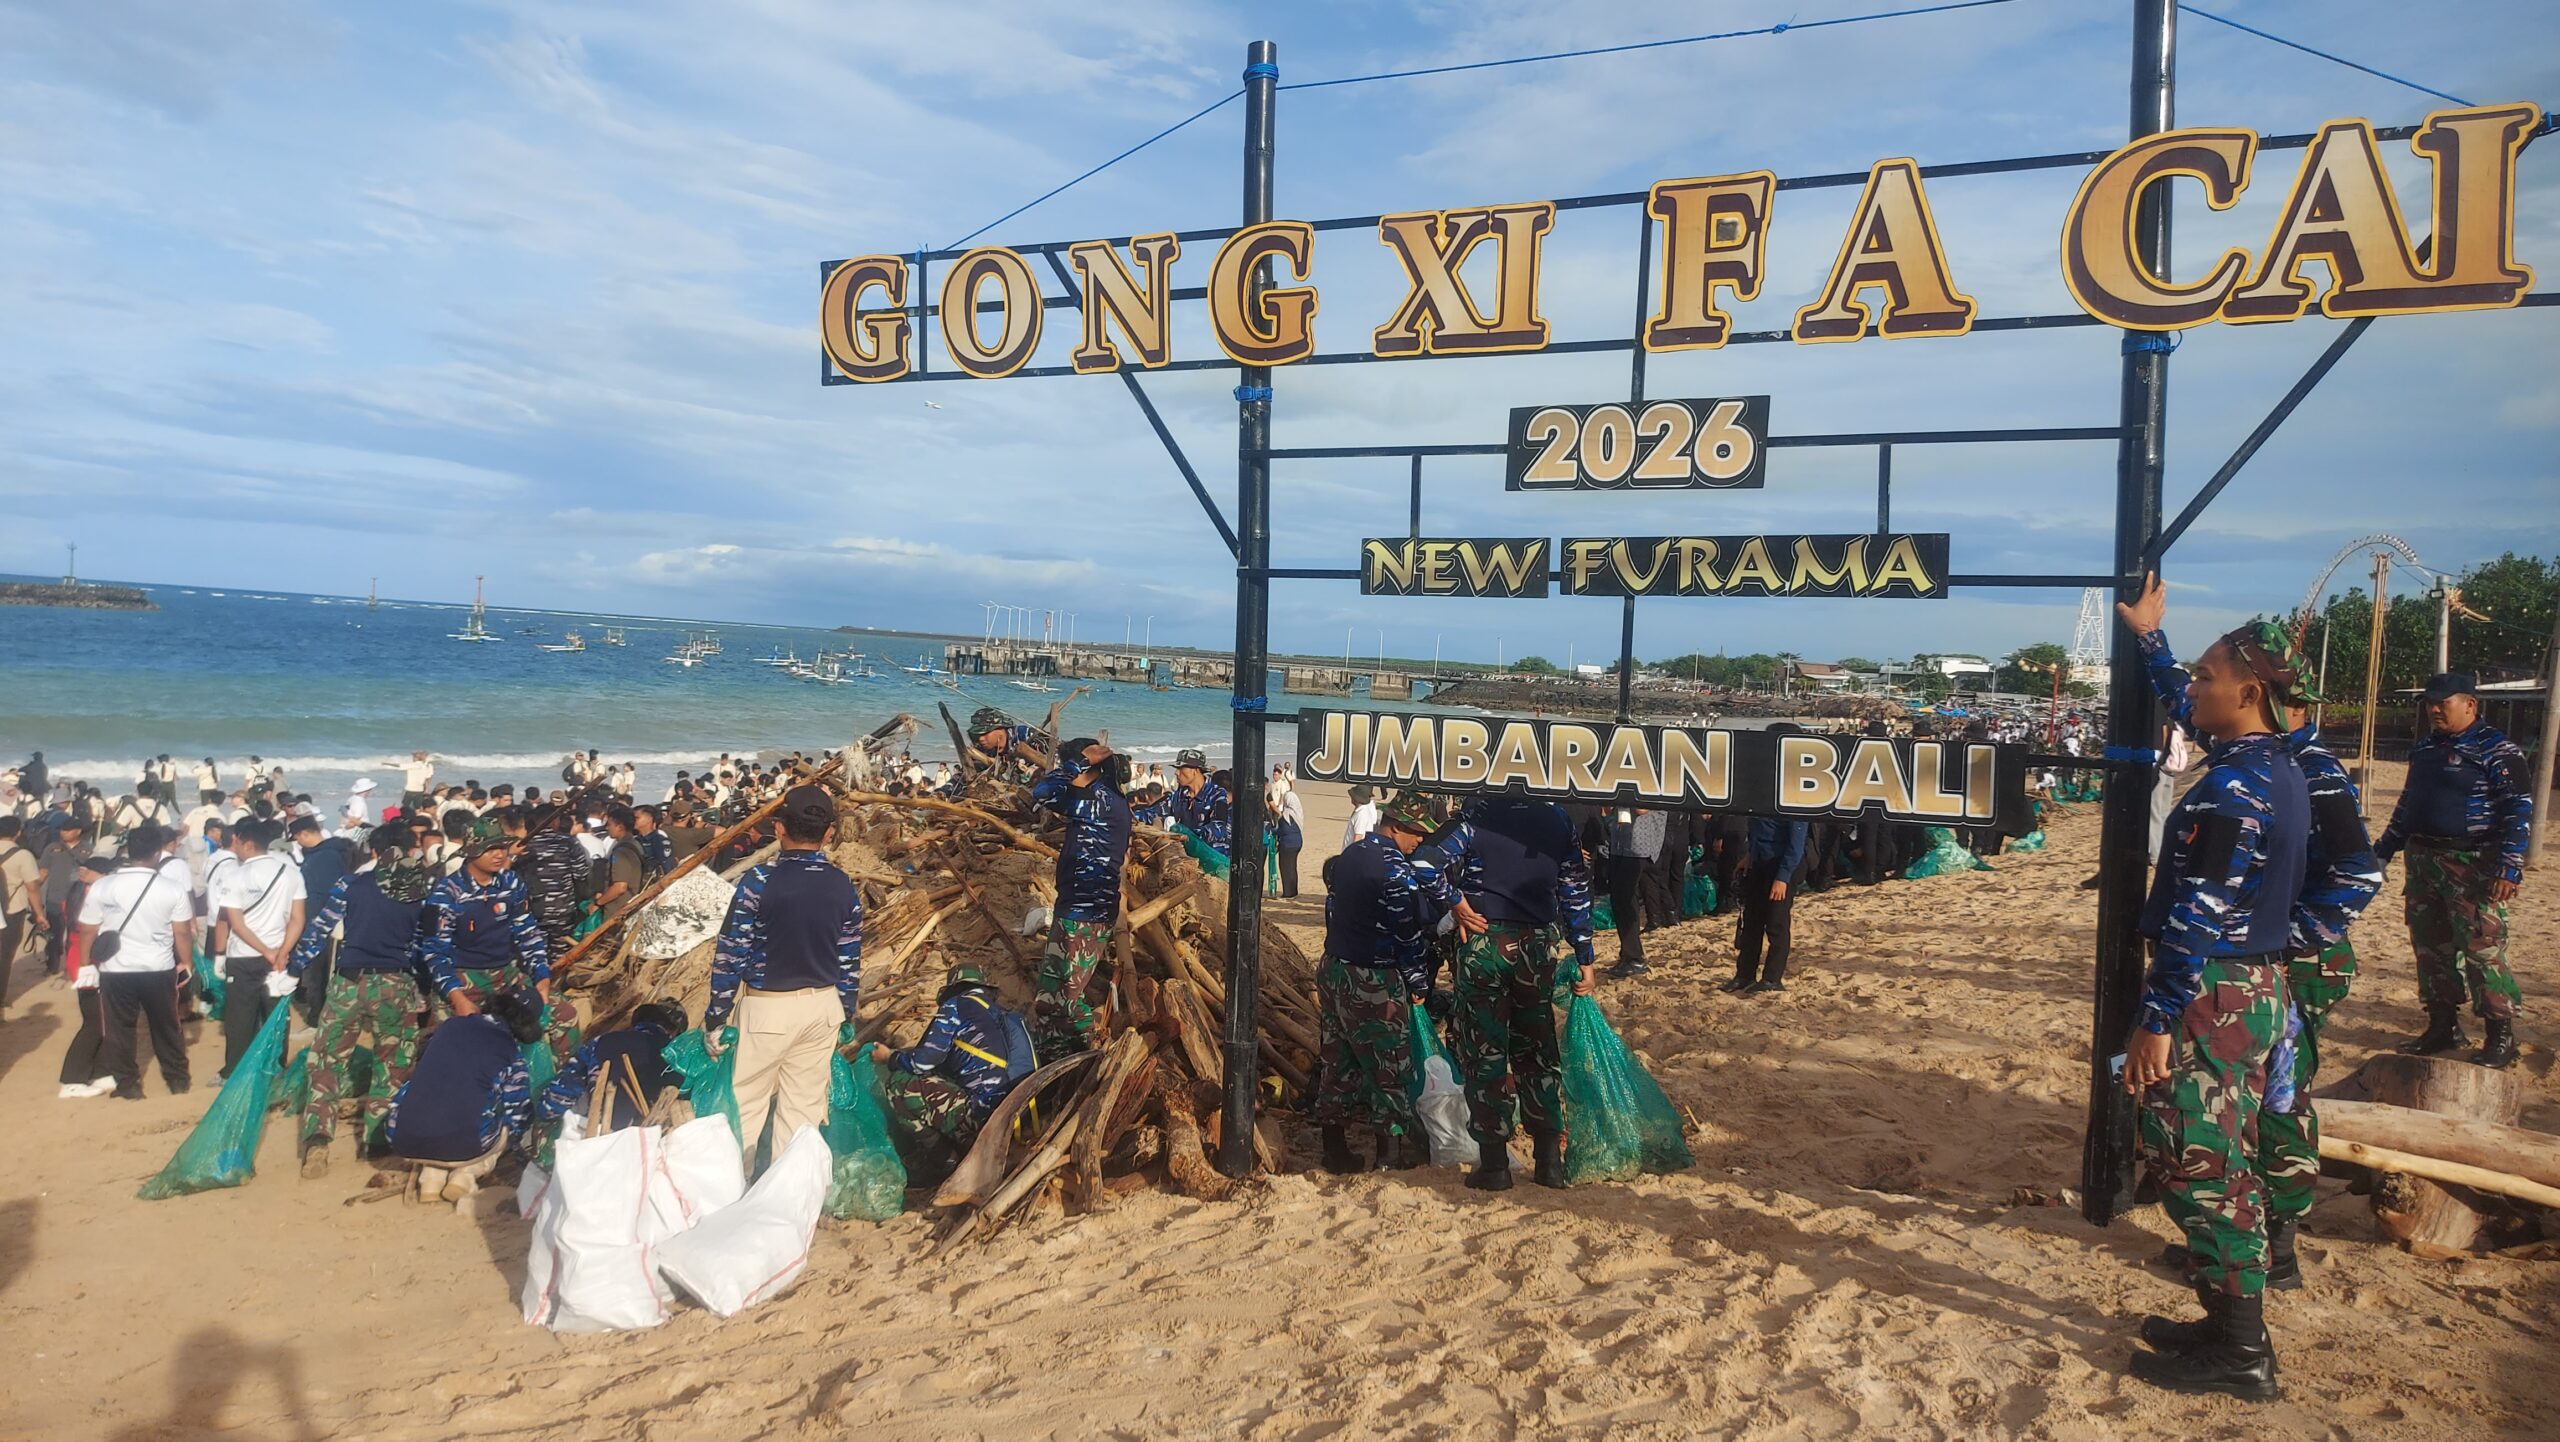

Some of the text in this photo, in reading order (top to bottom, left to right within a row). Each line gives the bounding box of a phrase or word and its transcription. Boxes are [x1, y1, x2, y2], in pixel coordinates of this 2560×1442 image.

[821, 101, 2541, 383] GONG XI F A CAI
[1522, 399, 1756, 487] 2026
[1364, 535, 1938, 598] NEW FURAMA
[1305, 710, 1998, 824] JIMBARAN BALI
